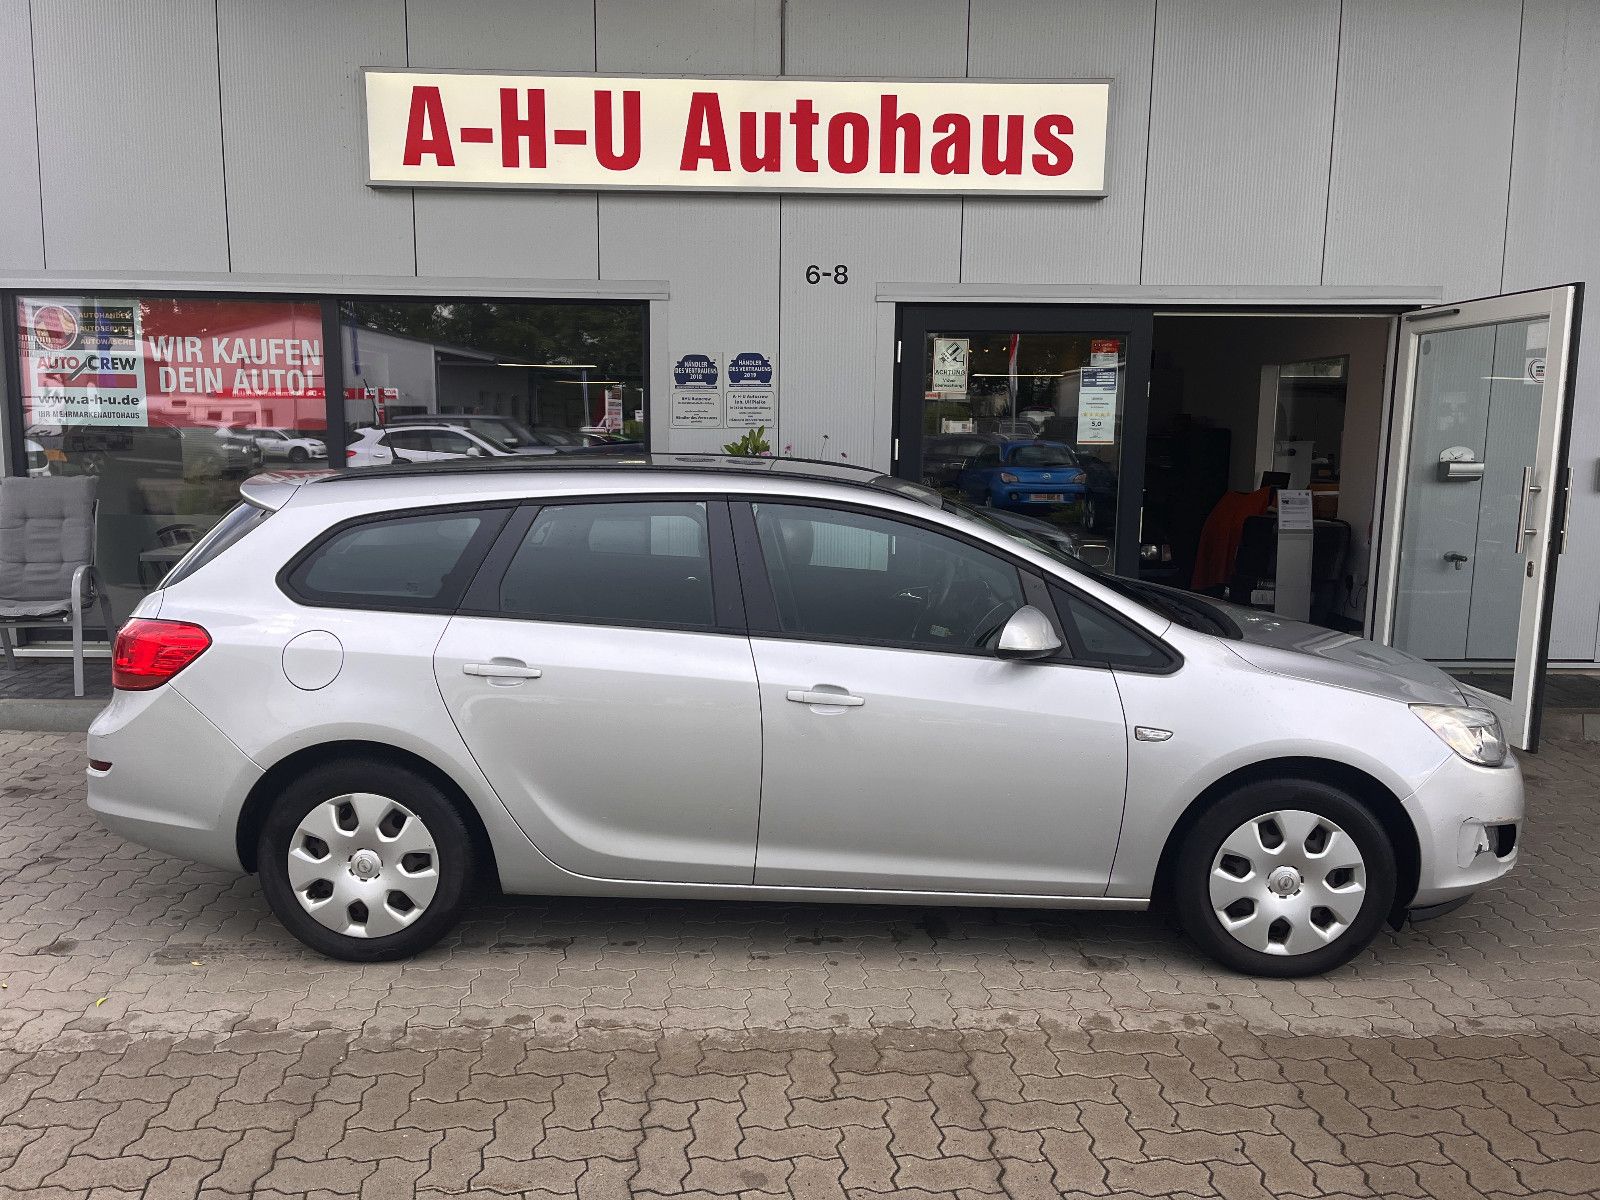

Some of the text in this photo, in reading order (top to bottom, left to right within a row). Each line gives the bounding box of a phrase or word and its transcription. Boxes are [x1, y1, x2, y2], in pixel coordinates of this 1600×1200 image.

[403, 86, 1074, 176] A-H-U Autohaus
[805, 264, 849, 285] 6-8
[147, 335, 321, 367] WIR KAUFEN
[37, 354, 137, 371] AUTO CREW
[159, 366, 314, 396] DEIN AUTO!
[38, 394, 140, 406] www.a-h-u.de
[38, 410, 140, 419] IHR MEHRMARKENAUTOHAUS
